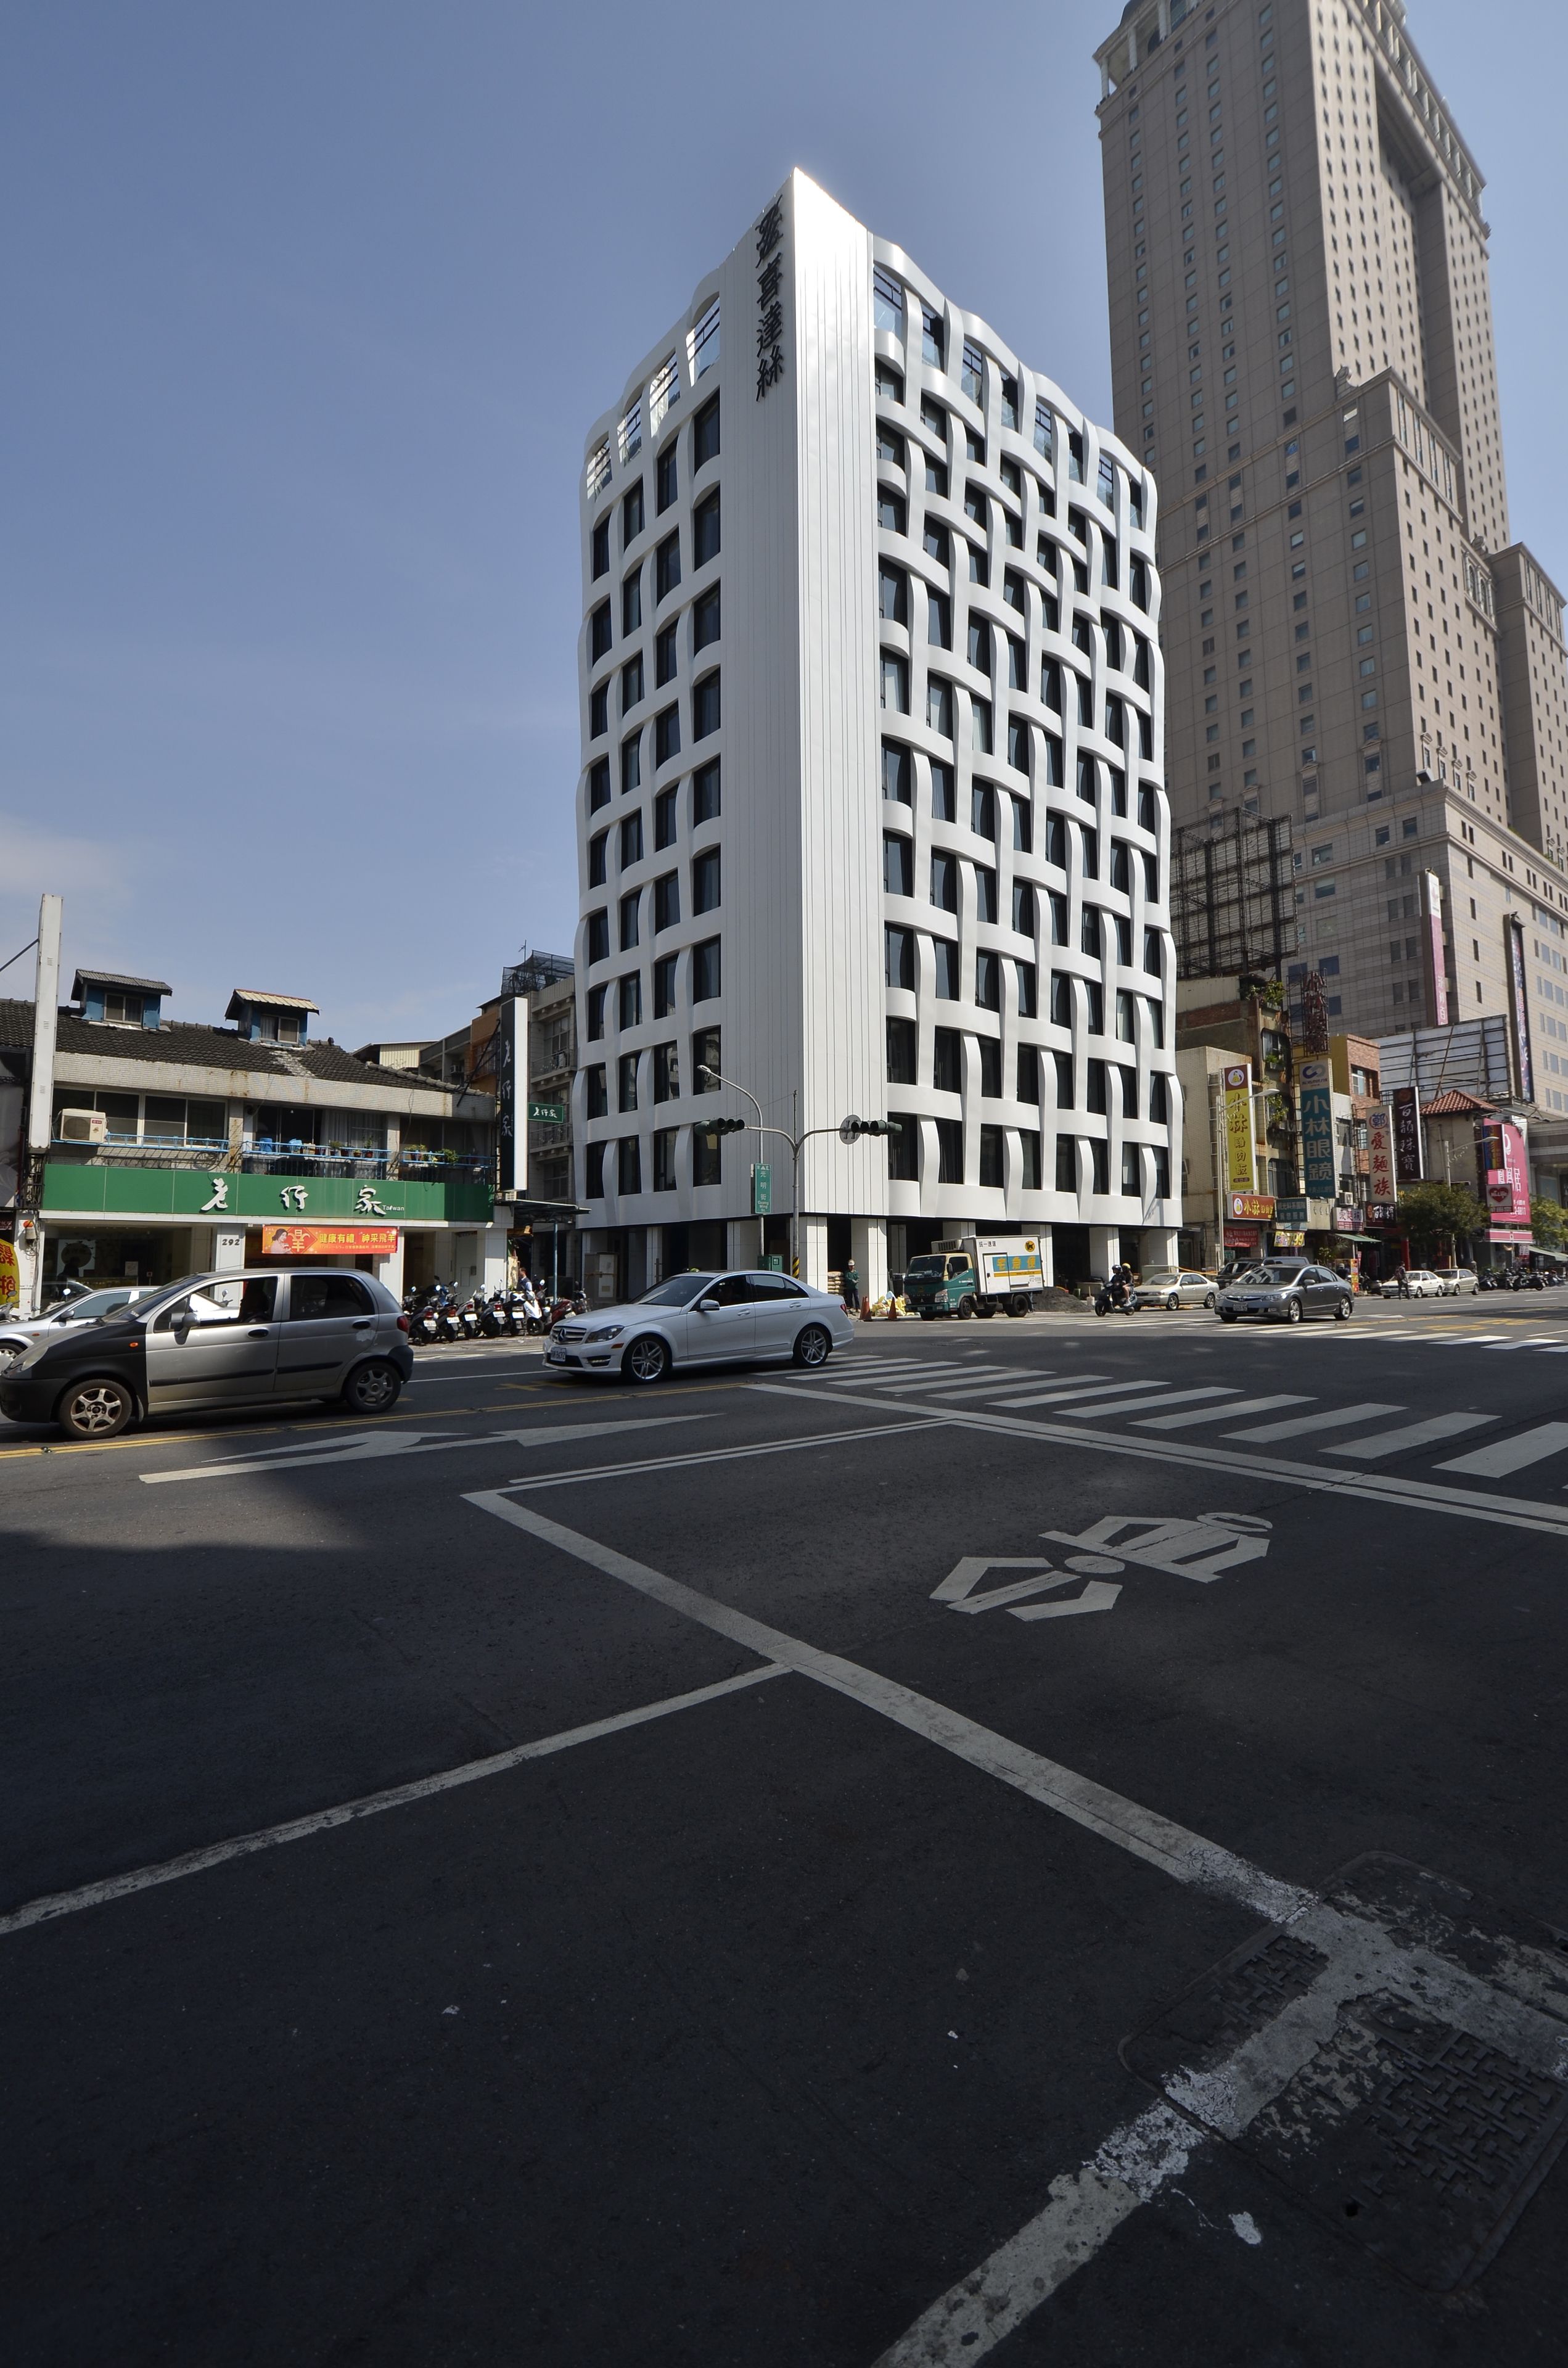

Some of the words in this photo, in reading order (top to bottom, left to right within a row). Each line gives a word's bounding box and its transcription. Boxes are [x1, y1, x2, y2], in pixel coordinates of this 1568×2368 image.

[501, 1040, 512, 1137] 老行家
[533, 1107, 557, 1118] 老行家
[1303, 1095, 1333, 1180] 小林眼鏡
[1398, 1103, 1416, 1171] 百韻珠寶
[1371, 1132, 1391, 1196] 愛麵族
[200, 1178, 386, 1216] 老行家
[319, 1233, 355, 1243] 健康有禮
[996, 1256, 1036, 1270] 宅急便
